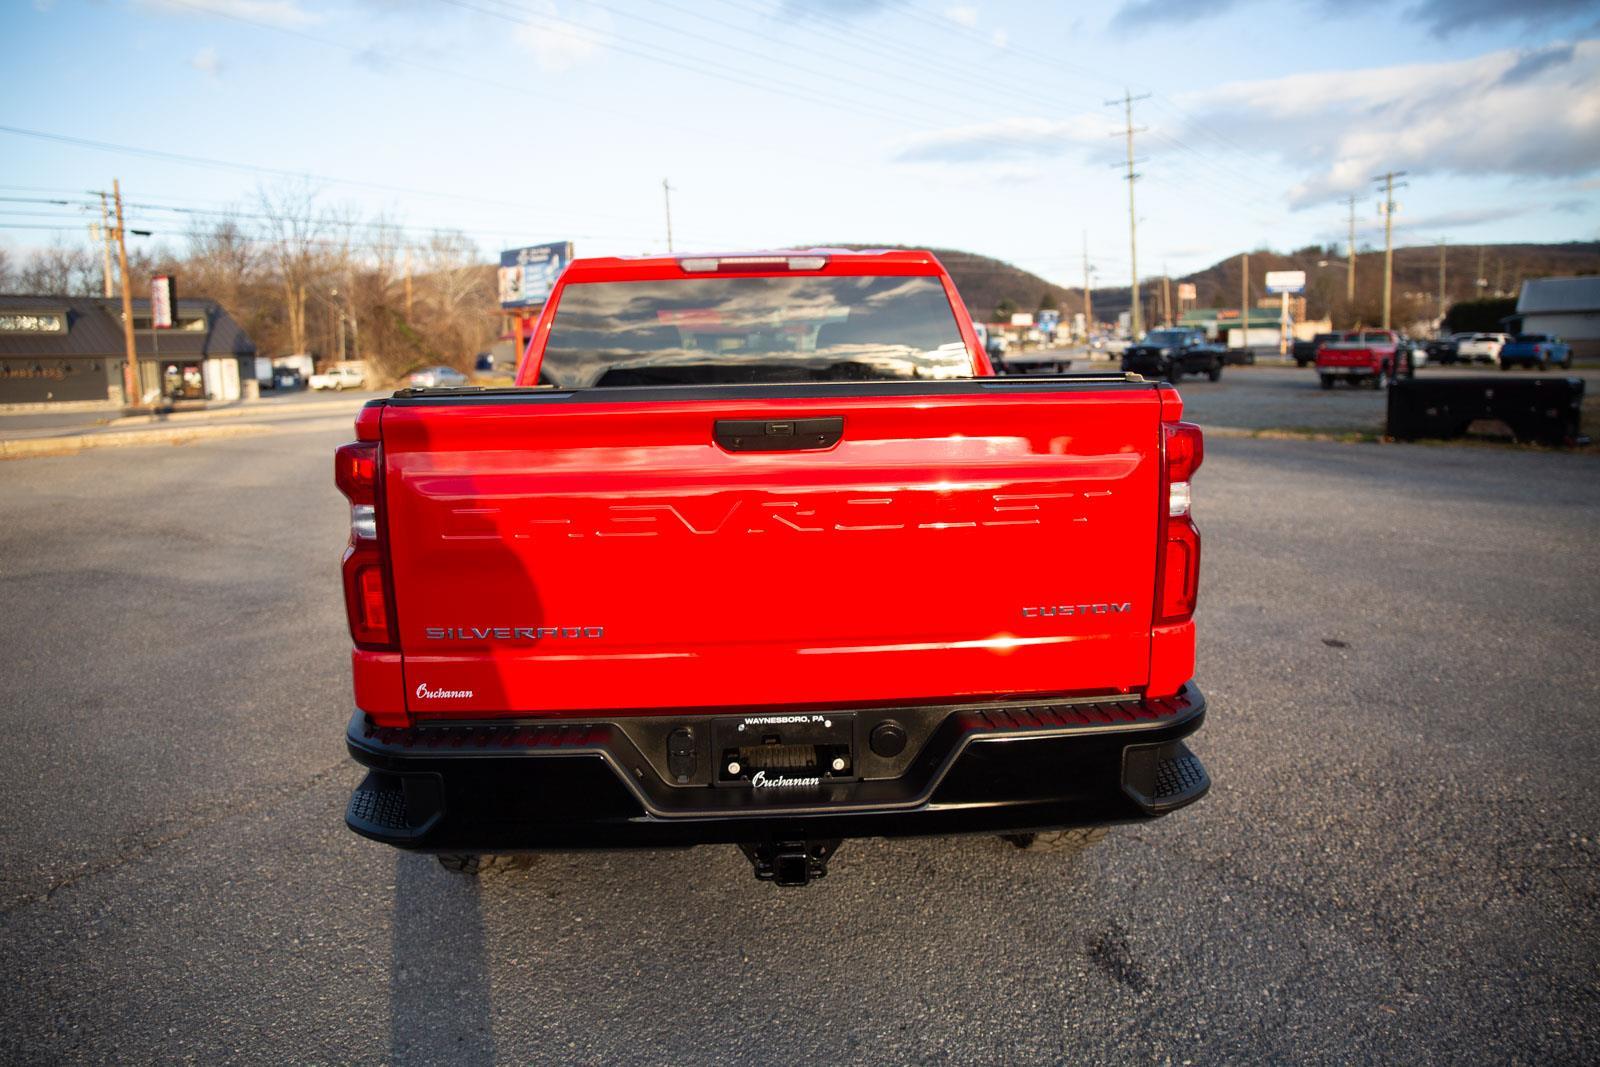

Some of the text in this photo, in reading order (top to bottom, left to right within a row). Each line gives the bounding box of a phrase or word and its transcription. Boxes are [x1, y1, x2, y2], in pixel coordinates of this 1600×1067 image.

[1022, 602, 1132, 617] CUSTOM
[425, 626, 605, 640] SILVERADO
[416, 683, 474, 699] Buchanan
[744, 716, 810, 725] WAYNESBORO,
[752, 770, 820, 788] Buchanan
